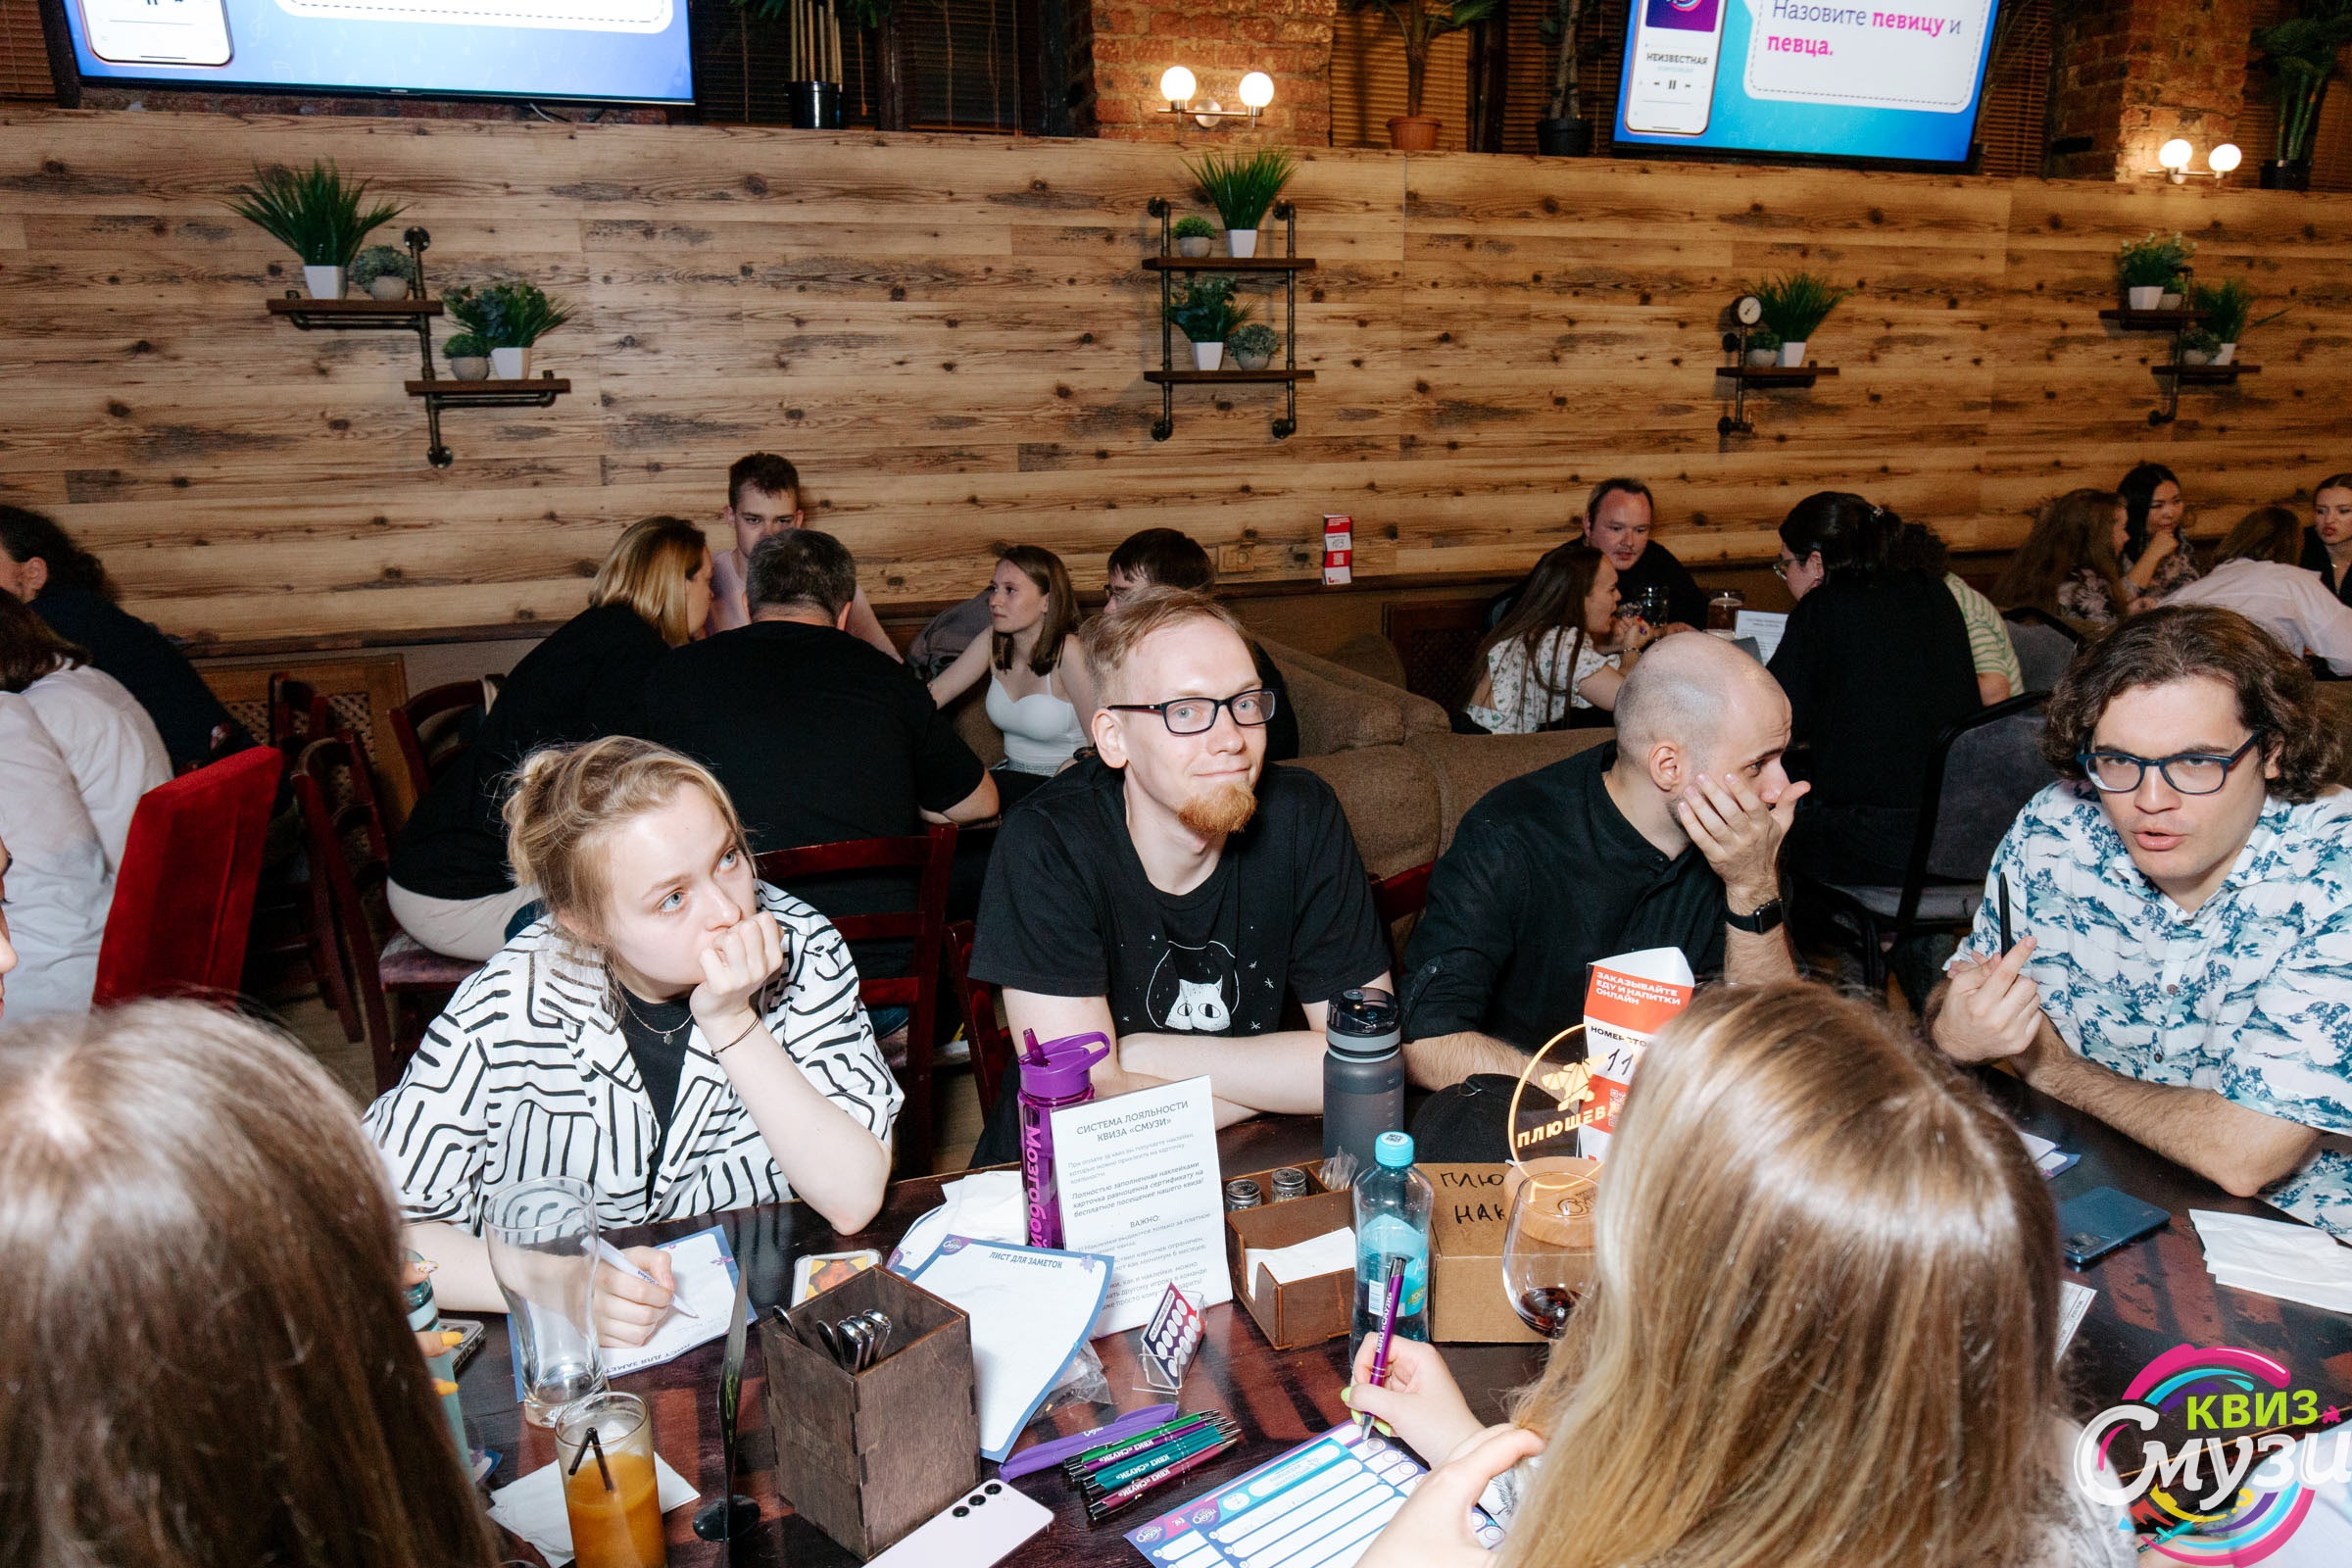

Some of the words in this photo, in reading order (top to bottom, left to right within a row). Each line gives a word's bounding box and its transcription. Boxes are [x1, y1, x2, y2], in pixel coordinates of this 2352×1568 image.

[1772, 0, 1866, 25] Назовите
[1872, 11, 1945, 37] певицу
[1948, 20, 1962, 34] и
[1767, 35, 1834, 57] певца.
[1645, 52, 1708, 66] НЕИЗВЕСТНАЯ
[1595, 979, 1617, 991] ЕДУ
[1627, 988, 1681, 1005] НАПИТКИ
[1596, 971, 1678, 997] ЗАКАЗЫВАЙТЕ
[1595, 987, 1640, 1005] ОНЛАЙН
[1608, 1049, 1634, 1076] 11
[1076, 1117, 1122, 1135] СИСТЕМА
[1123, 1102, 1188, 1123] ЛОЯЛЬНОСТИ
[1097, 1128, 1127, 1143] КВИЗА
[1128, 1117, 1171, 1134] «СМУЗИ»
[1158, 1162, 1200, 1177] наклейками
[1441, 1172, 1504, 1188] ПЛЮ
[1073, 1202, 1115, 1218] бесплатное
[1156, 1186, 1181, 1195] нашего
[1129, 1215, 1160, 1228] ВАЖНО:
[1454, 1203, 1505, 1224] НАК
[989, 1251, 1010, 1262] ЛИСТ
[1027, 1257, 1063, 1269] ЗАМЕТОК
[605, 1360, 638, 1373] ЗАМЕТ
[1134, 1439, 1154, 1449] КВИЗ
[1099, 1446, 1133, 1463] «СМУЗИ»
[1151, 1454, 1170, 1465] КВИЗ
[1115, 1462, 1150, 1480] «СМУЗИ»
[1152, 1468, 1171, 1482] КВИЗ
[1117, 1477, 1152, 1497] «СМУЗИ»
